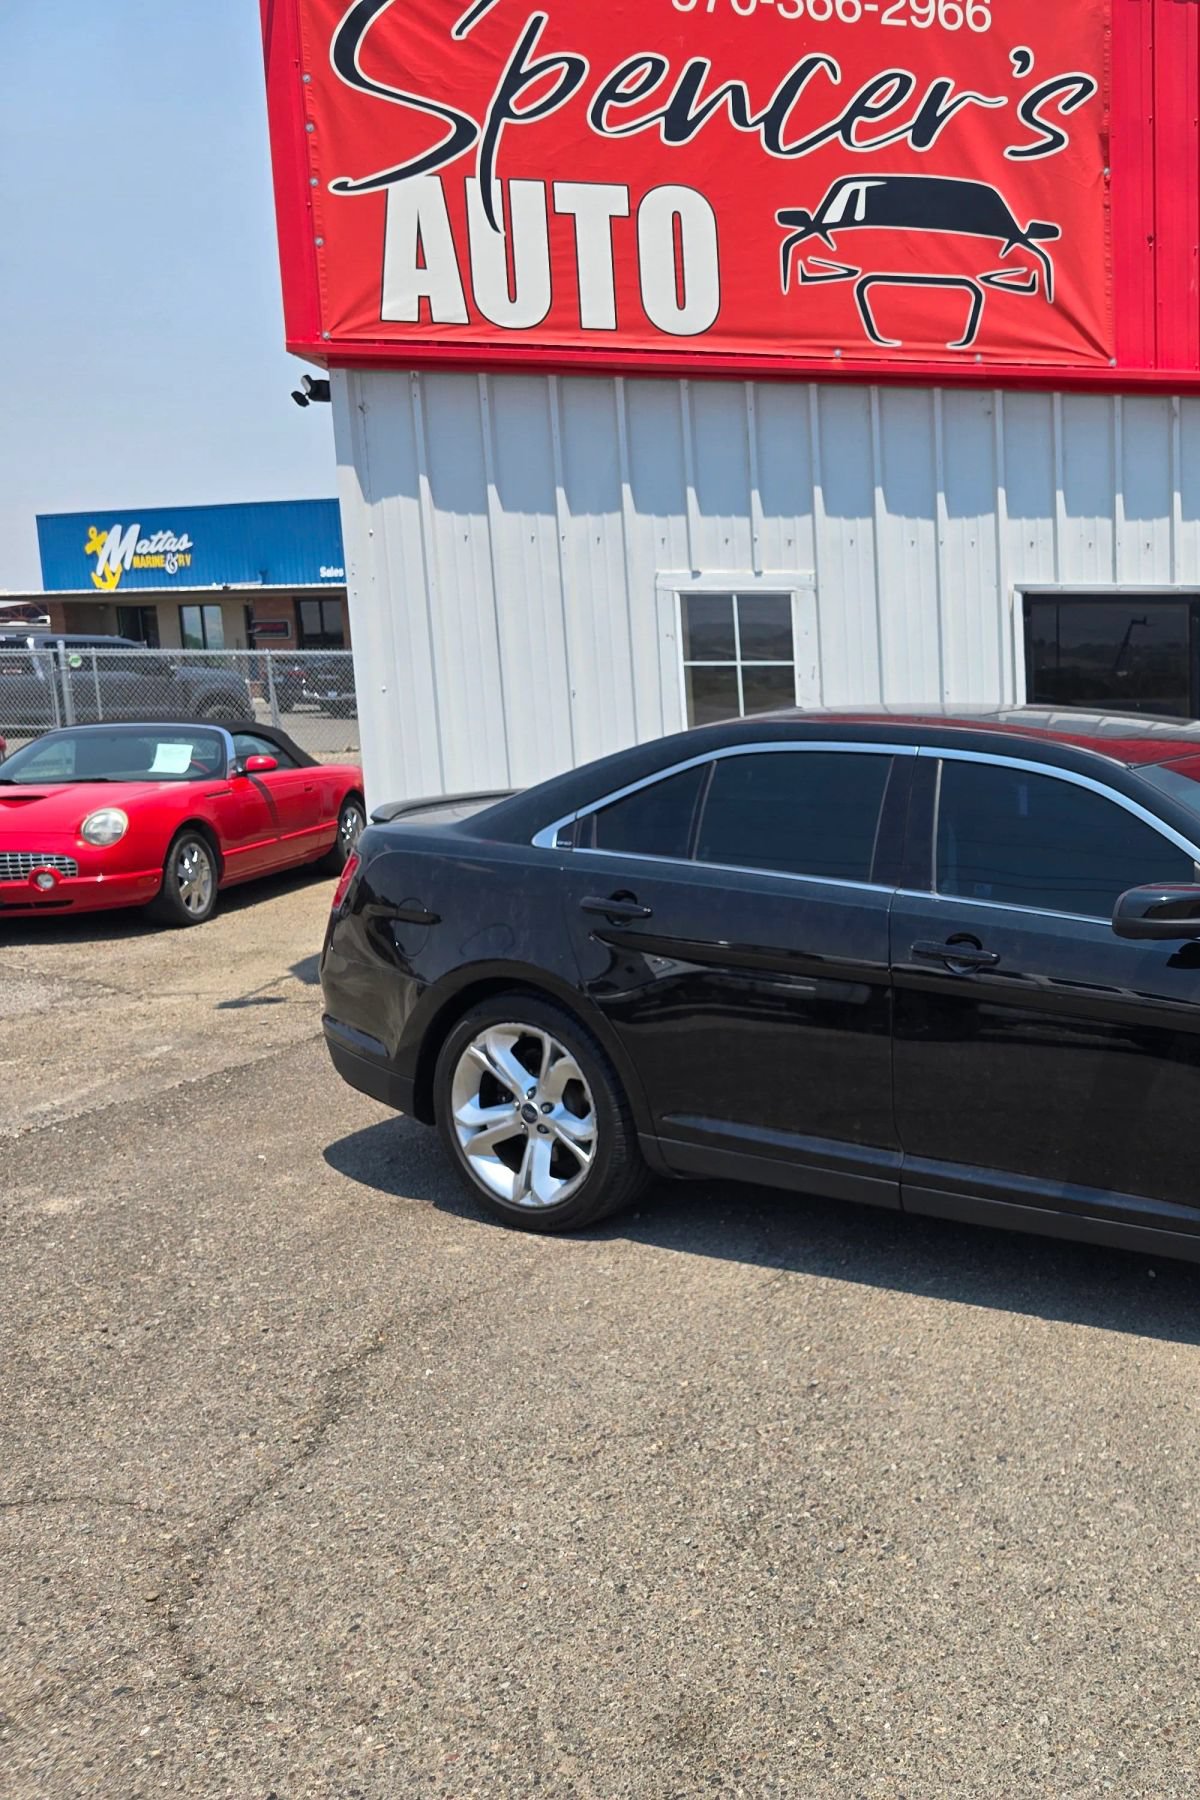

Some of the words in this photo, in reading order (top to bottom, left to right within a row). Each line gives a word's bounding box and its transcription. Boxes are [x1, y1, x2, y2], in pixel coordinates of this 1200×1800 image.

[328, 0, 1097, 236] Spencer's
[379, 173, 721, 337] AUTO
[96, 523, 193, 577] Mattas
[133, 554, 165, 569] MARINE
[177, 553, 192, 568] RV
[319, 565, 345, 578] Sales
